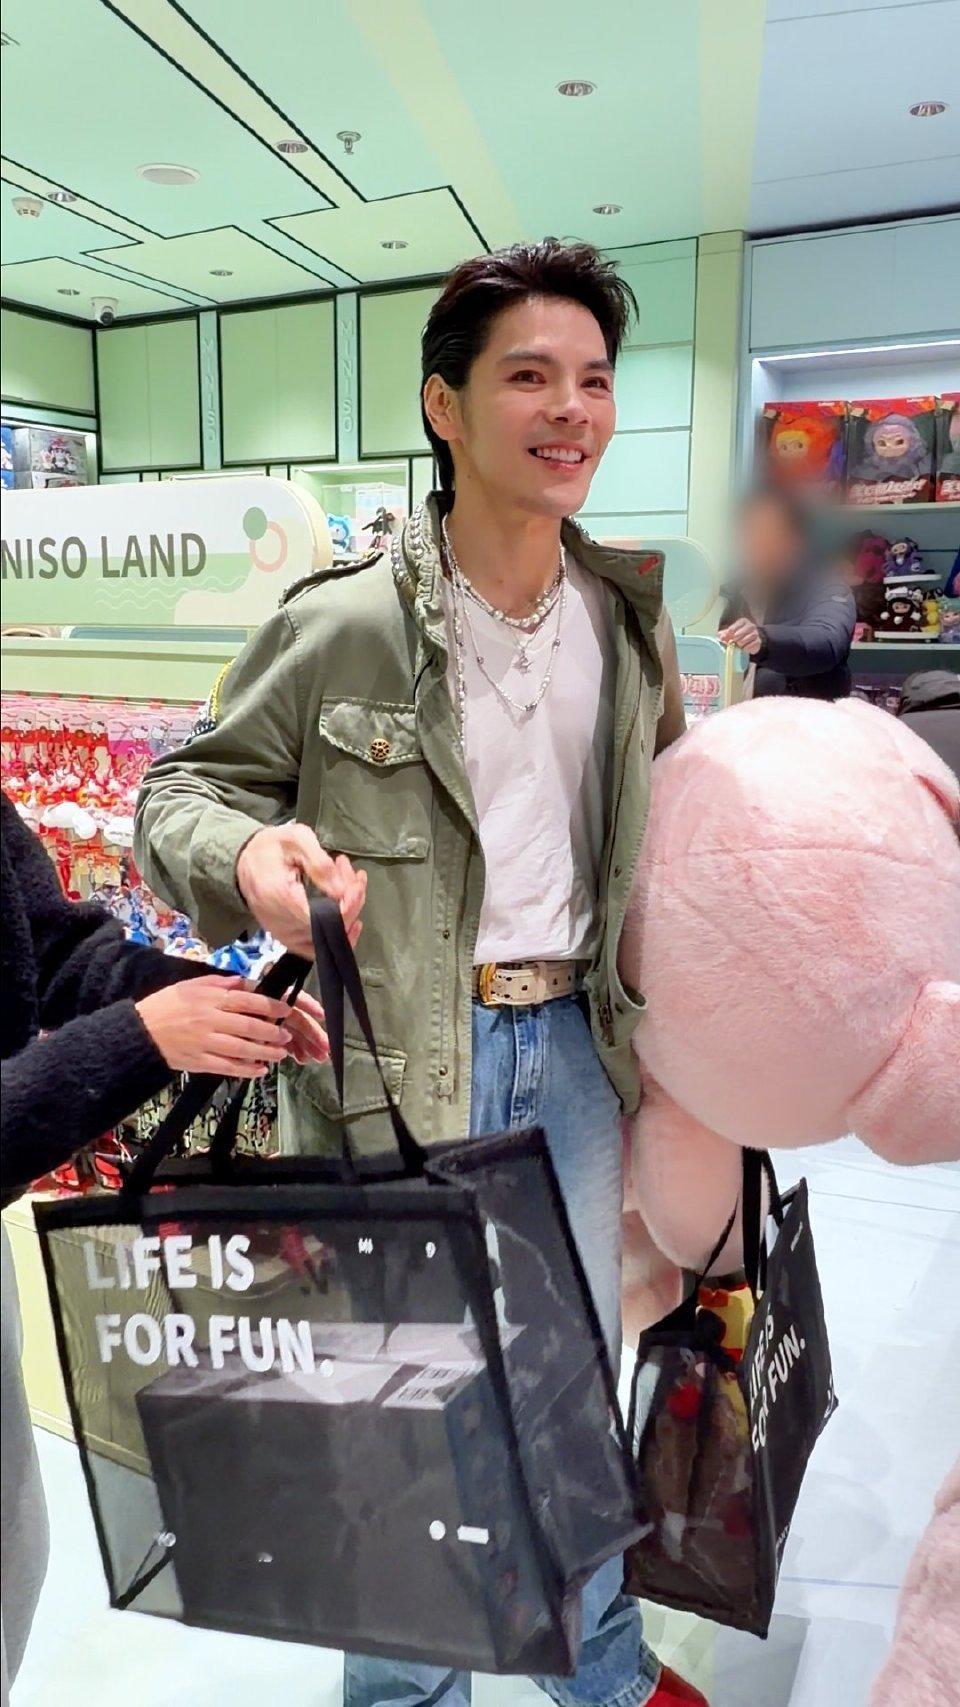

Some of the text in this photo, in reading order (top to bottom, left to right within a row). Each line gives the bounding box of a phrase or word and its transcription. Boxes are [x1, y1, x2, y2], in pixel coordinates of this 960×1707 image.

[341, 319, 354, 432] MINISO
[101, 533, 207, 578] LAND
[84, 1234, 255, 1291] LIFE IS
[96, 1313, 335, 1378] FOR FUN.
[767, 1324, 806, 1403] FUN.
